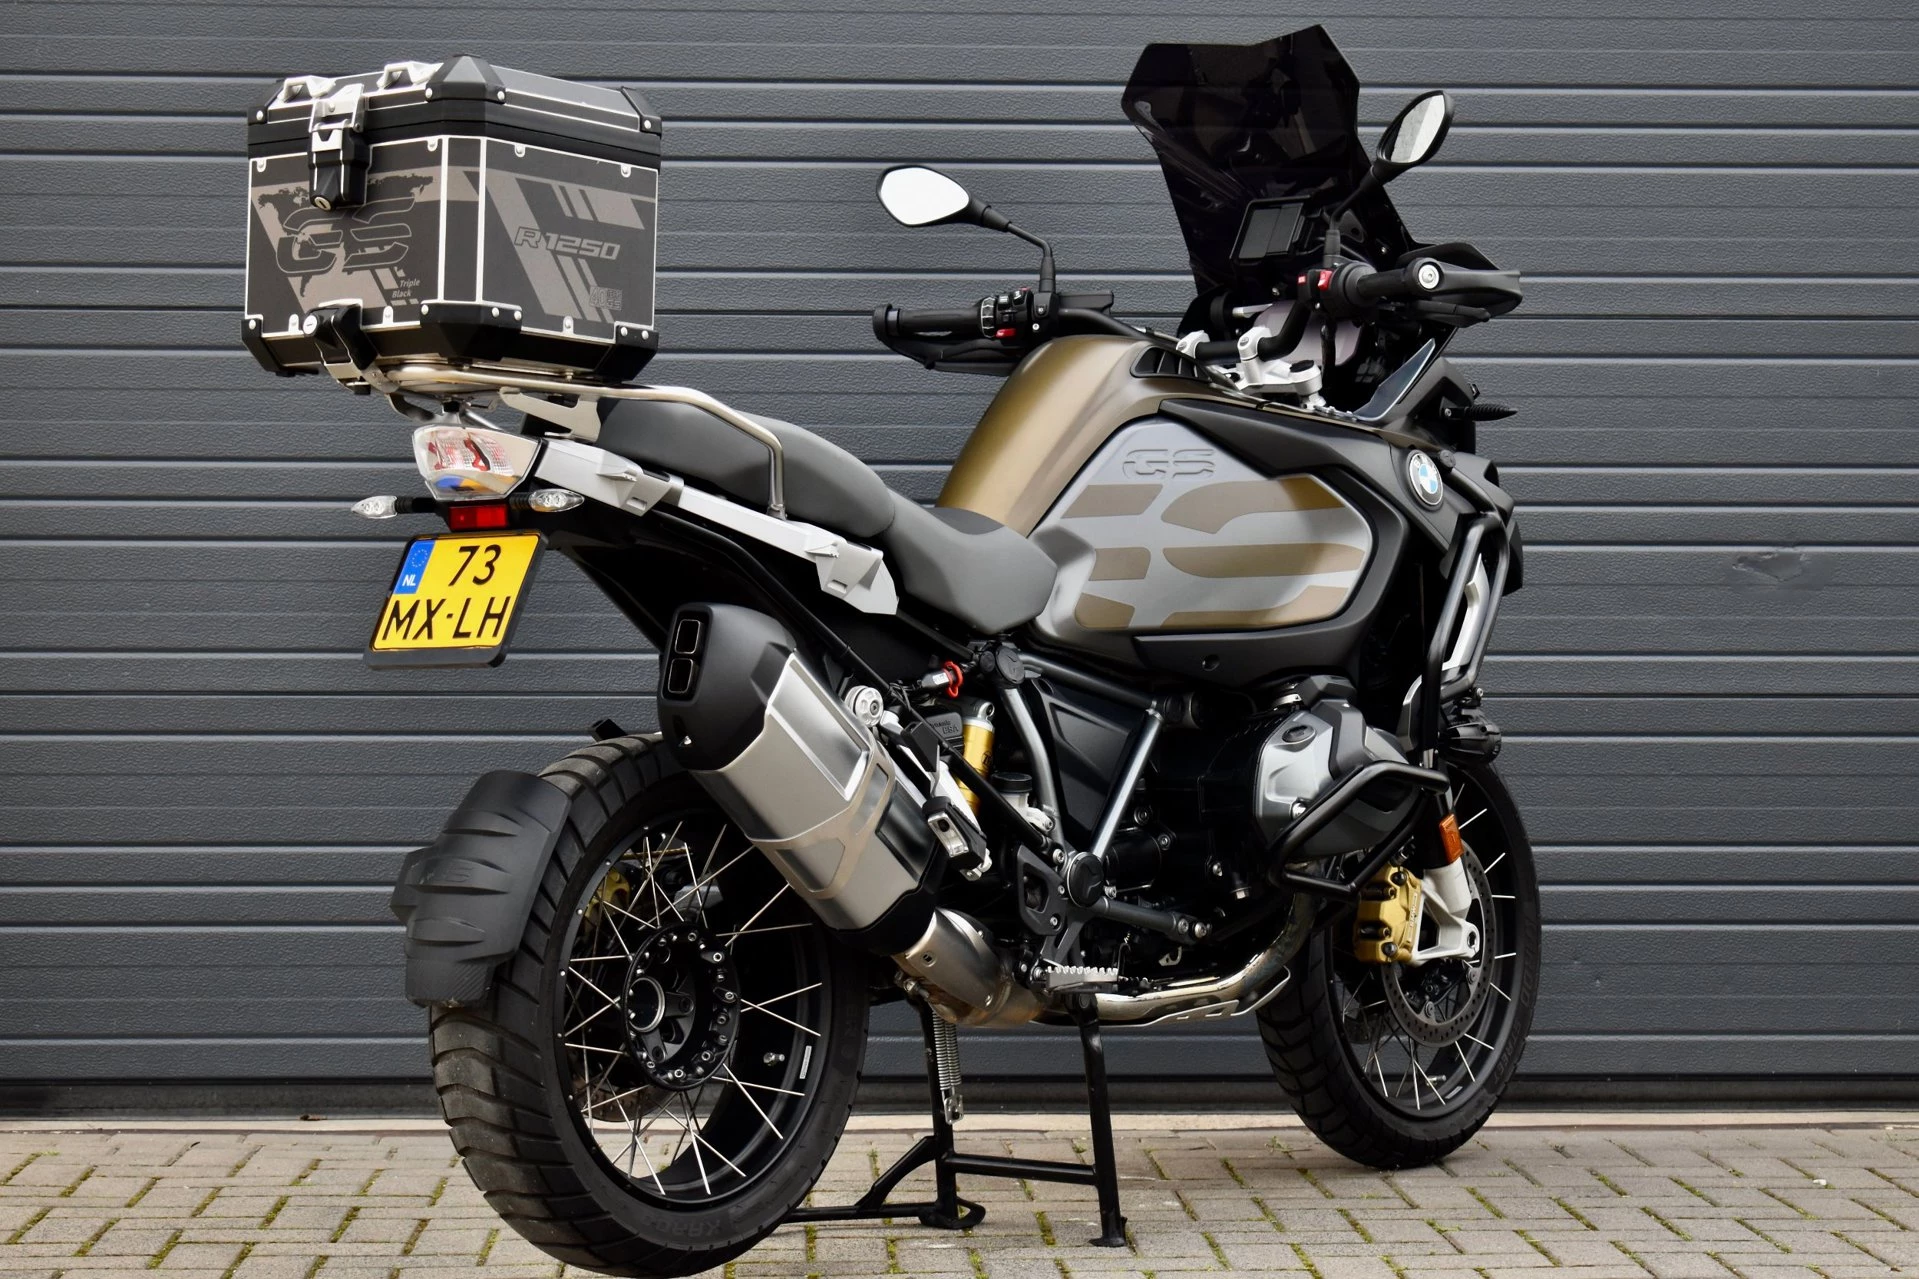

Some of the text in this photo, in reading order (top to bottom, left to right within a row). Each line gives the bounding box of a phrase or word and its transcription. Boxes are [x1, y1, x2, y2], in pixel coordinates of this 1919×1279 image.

[399, 278, 421, 288] Triple
[391, 289, 412, 299] Black
[1121, 448, 1217, 480] GS
[448, 544, 502, 587] 73
[401, 573, 417, 587] NL
